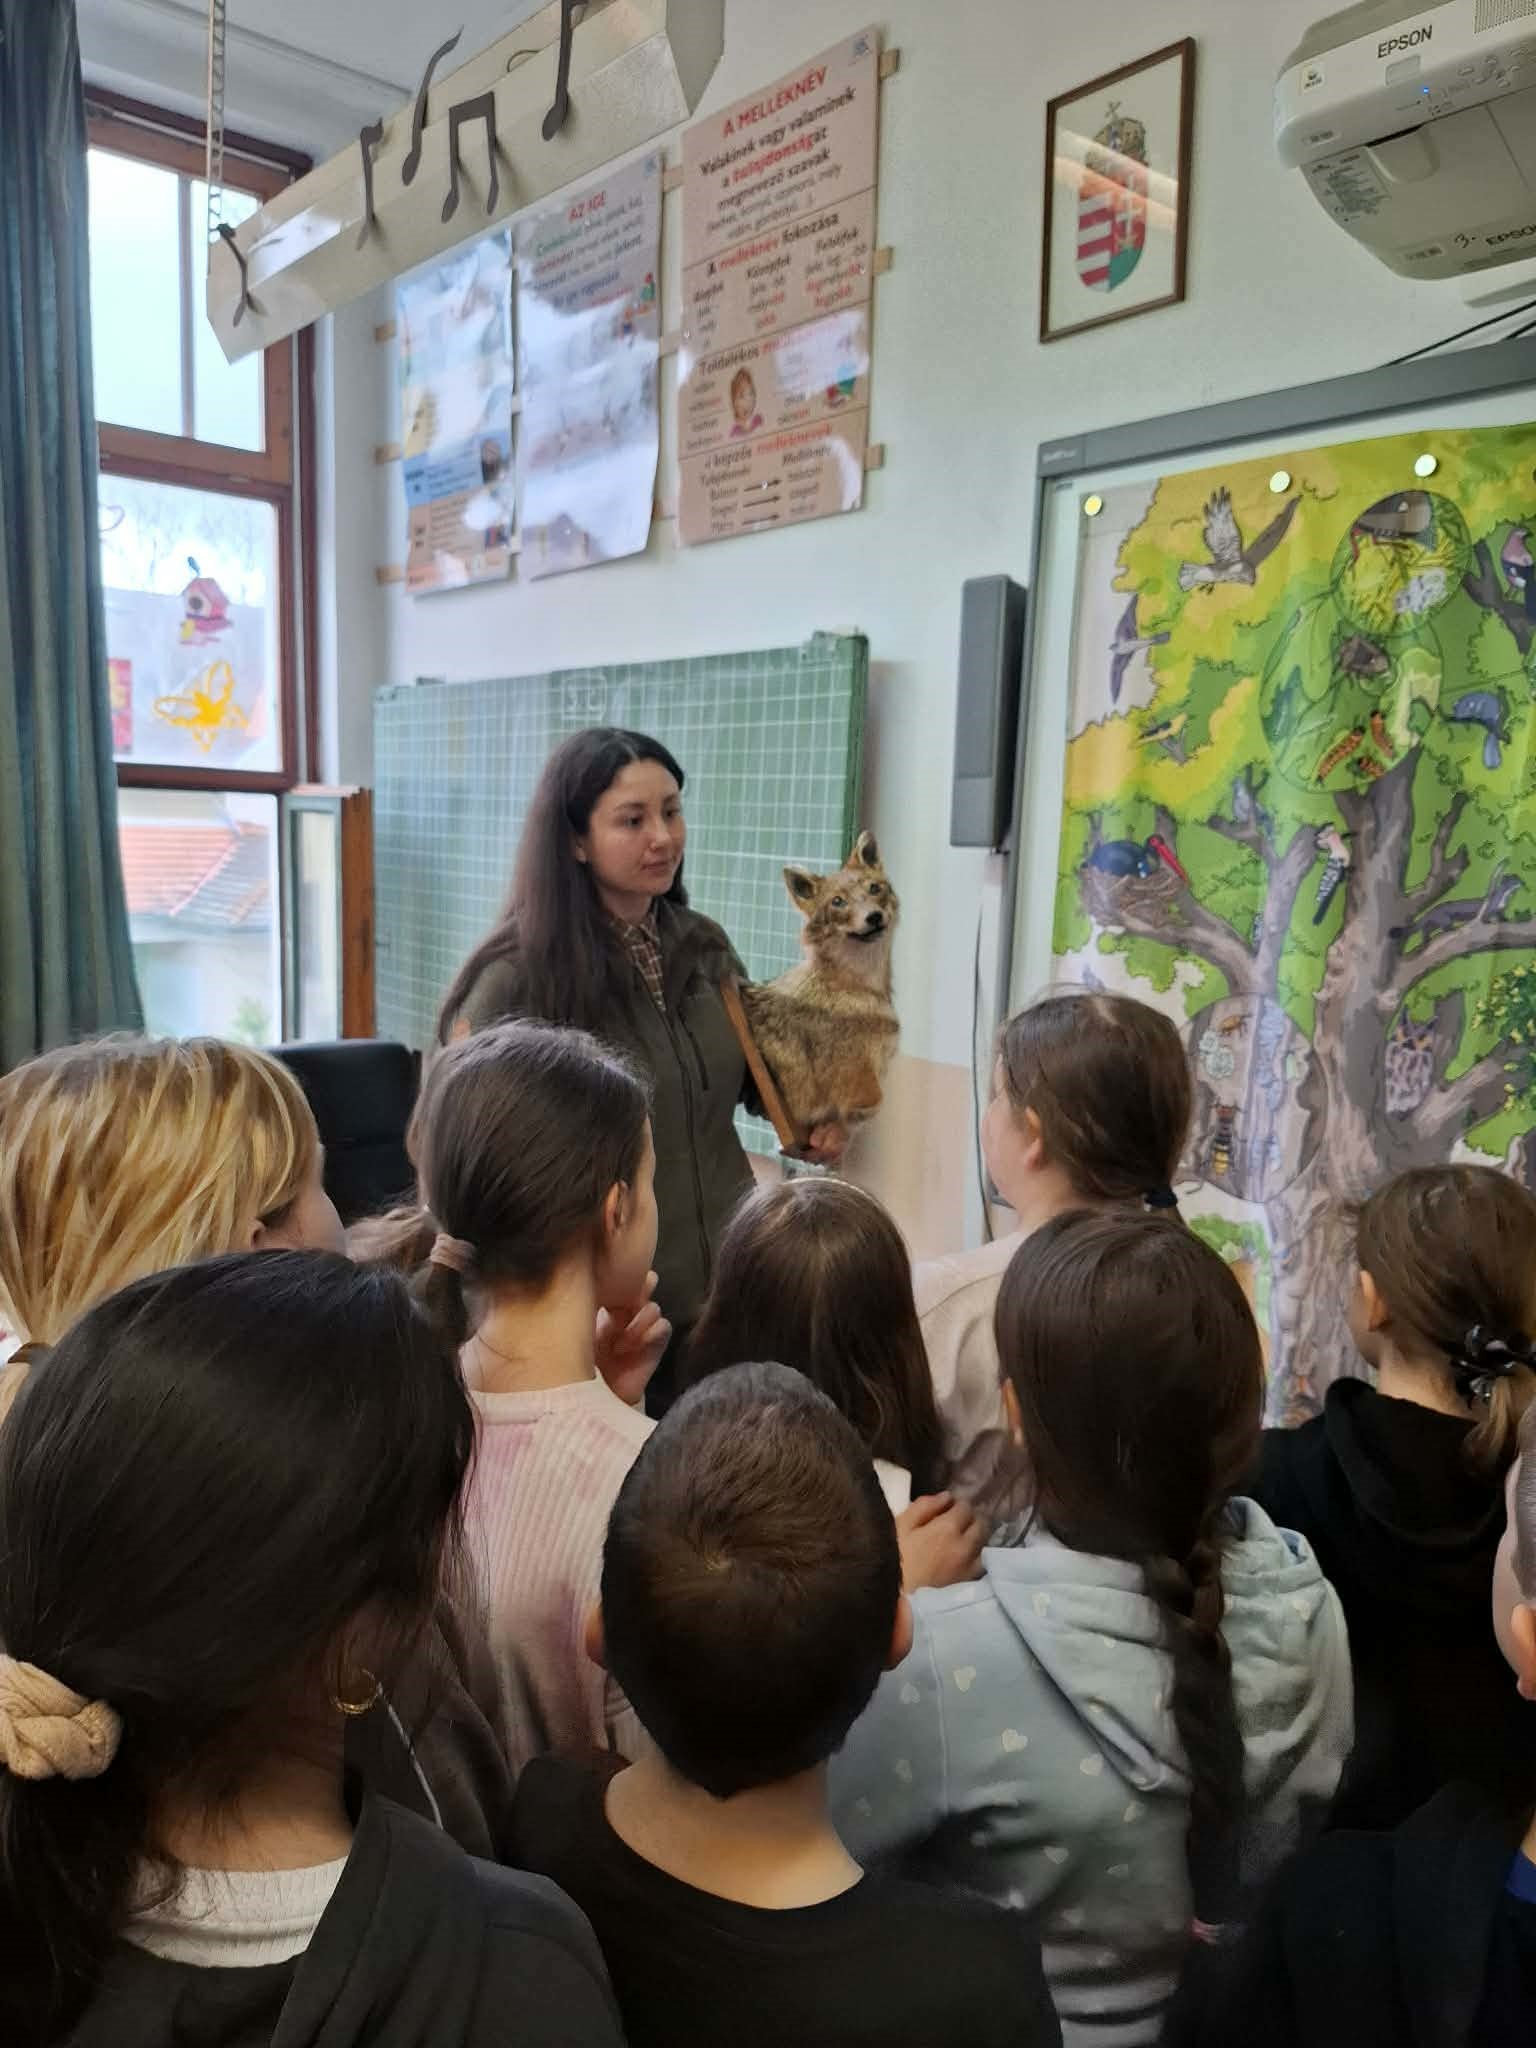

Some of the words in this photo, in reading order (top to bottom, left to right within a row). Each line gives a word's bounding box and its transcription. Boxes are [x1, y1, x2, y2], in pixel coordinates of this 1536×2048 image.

[1377, 25, 1433, 58] EPSON
[722, 118, 734, 138] A
[758, 127, 787, 149] vagy
[1486, 224, 1536, 245] EPSO
